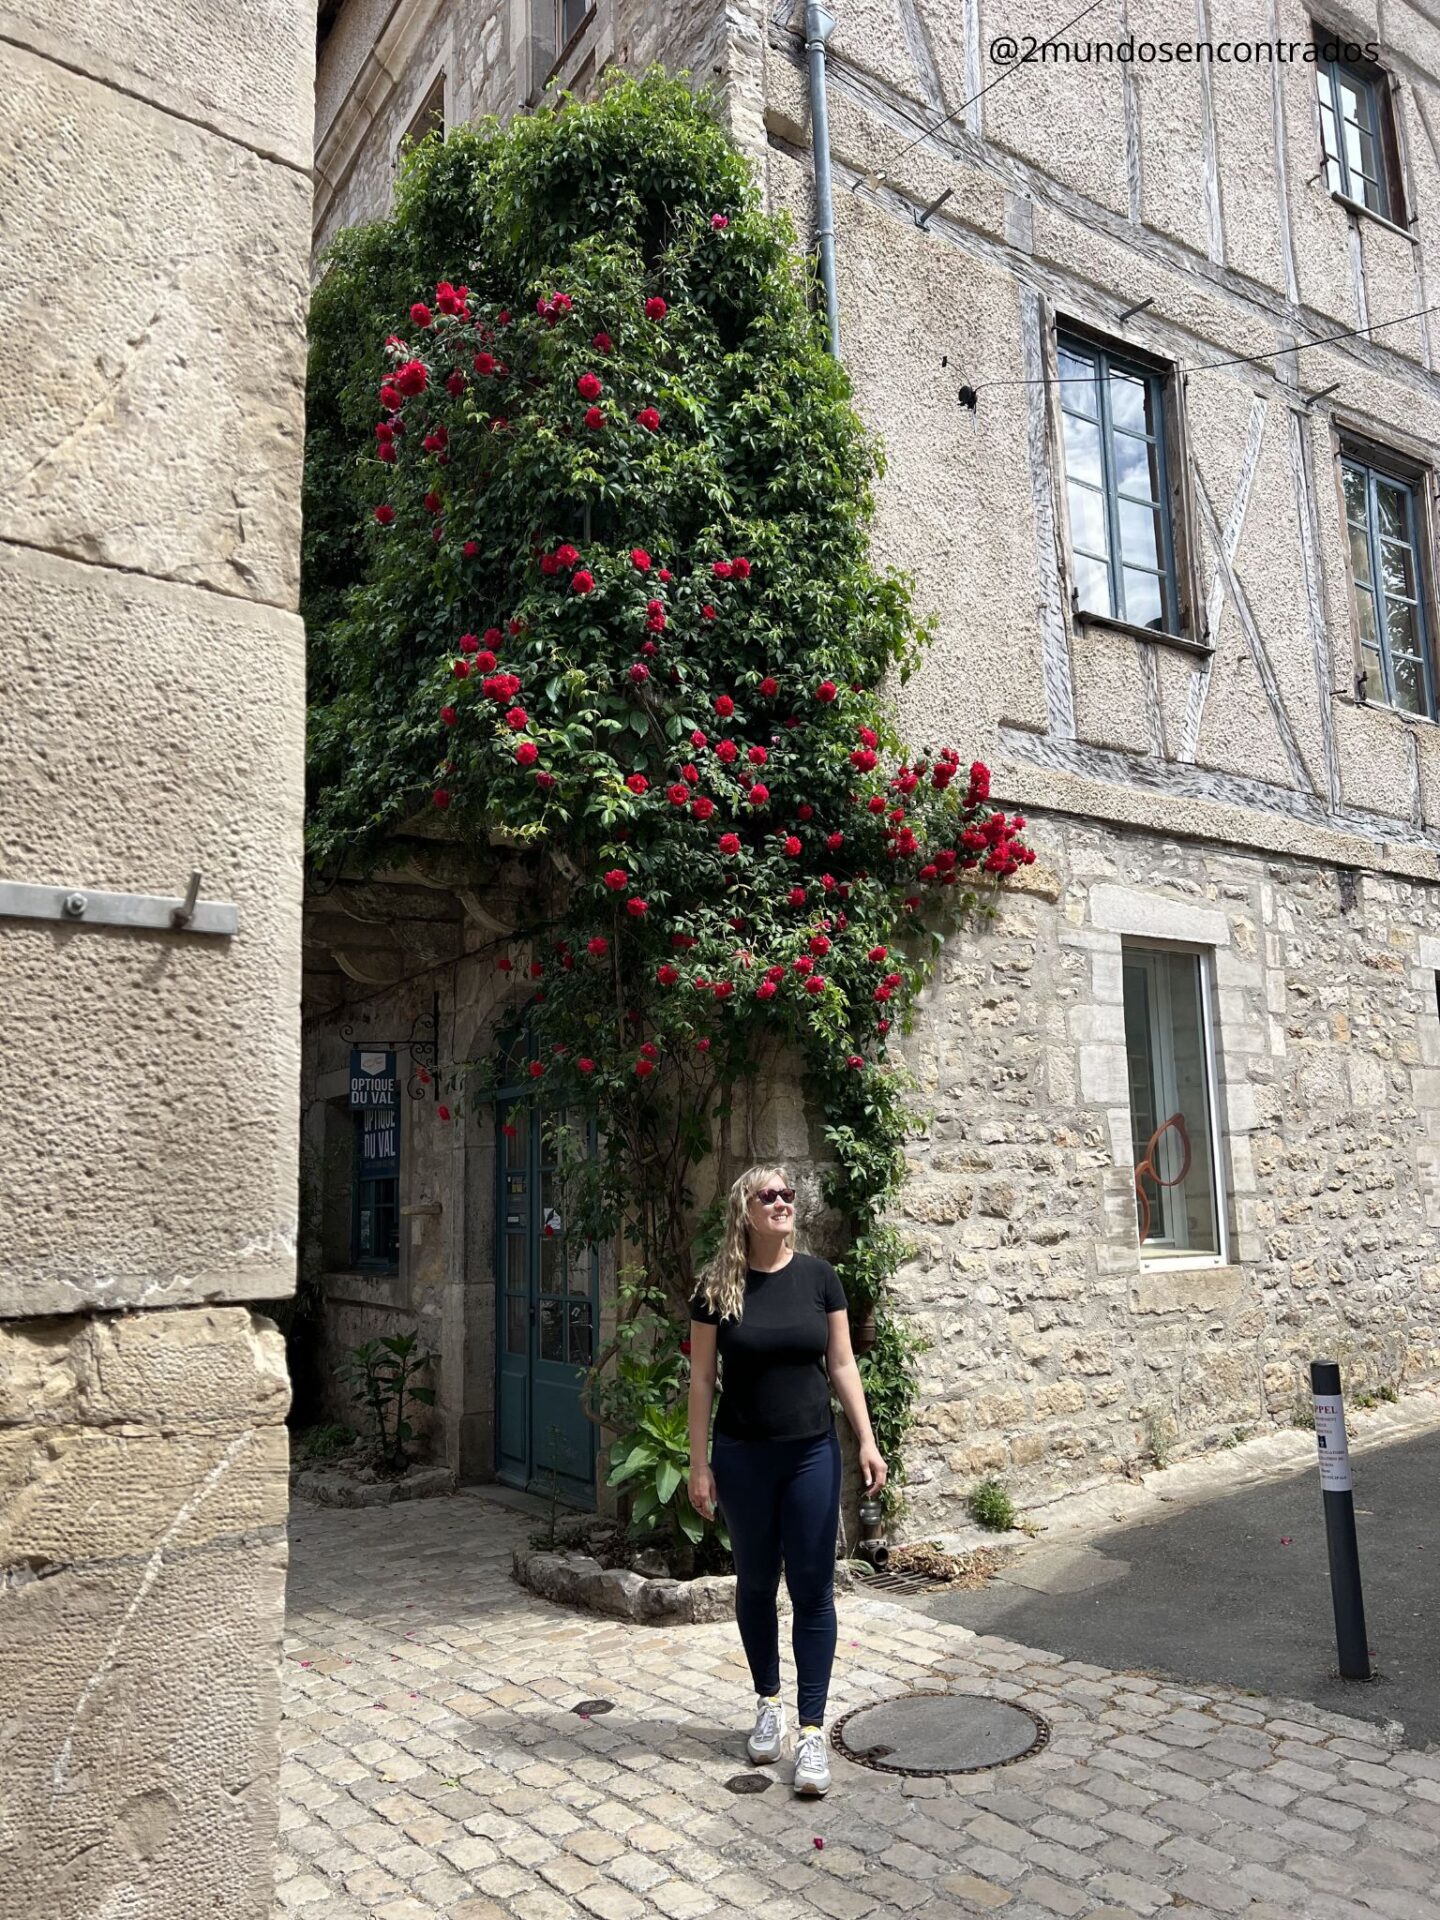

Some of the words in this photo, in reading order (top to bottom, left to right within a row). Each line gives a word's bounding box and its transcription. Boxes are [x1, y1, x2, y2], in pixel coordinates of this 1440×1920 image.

[351, 1078, 394, 1092] OPTIQUE
[351, 1091, 368, 1104] DU
[371, 1091, 395, 1104] VAL
[364, 1133, 376, 1160] DU
[378, 1129, 396, 1158] VAL
